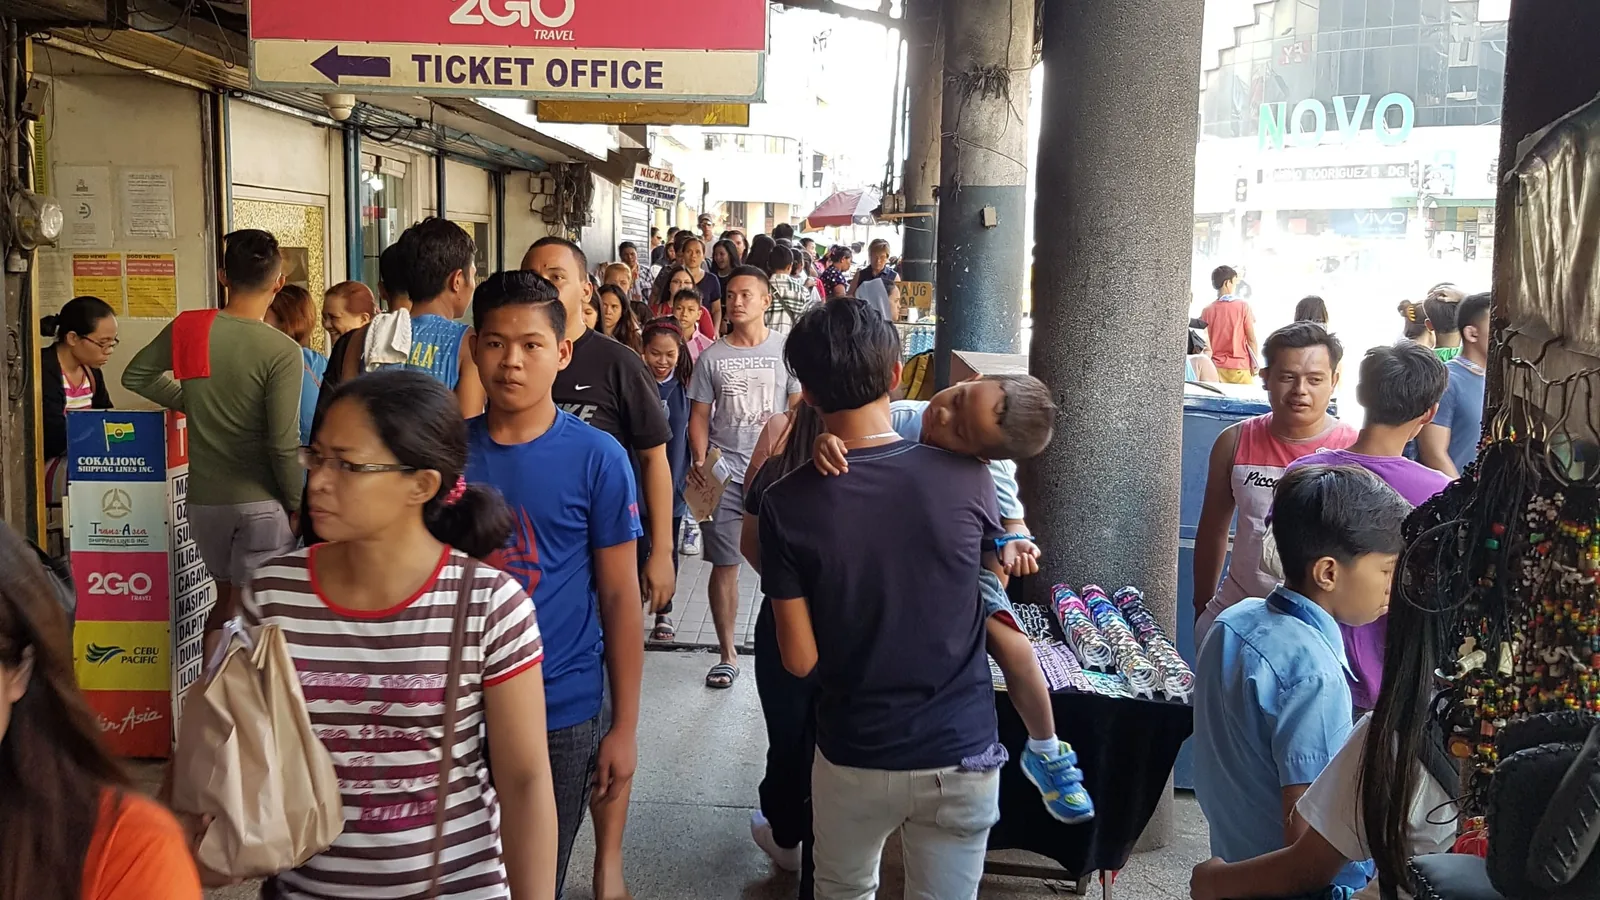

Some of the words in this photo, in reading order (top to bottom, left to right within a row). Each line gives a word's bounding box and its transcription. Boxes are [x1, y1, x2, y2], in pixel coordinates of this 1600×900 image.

[449, 0, 575, 27] 2GO
[534, 29, 575, 41] TRAVEL
[412, 54, 534, 87] TICKET
[546, 58, 664, 90] OFFICE
[1259, 92, 1415, 151] NOVO
[641, 167, 660, 180] NICK
[1305, 166, 1369, 180] RODRIGUEZ
[635, 179, 646, 188] KEY
[647, 183, 677, 194] DUPLICATE
[657, 191, 676, 201] STAMP
[1353, 209, 1405, 225] vivo
[716, 356, 778, 370] RESPECT
[77, 456, 145, 466] COKALIONG
[77, 465, 114, 473] SHIPPING
[115, 465, 138, 473] LINES
[139, 465, 155, 473] INC.
[178, 545, 202, 570] ILIGA
[87, 572, 152, 595] 2GO
[178, 565, 211, 593] CAGAYA
[178, 586, 211, 617] NASIPIT
[133, 646, 160, 655] CEBU
[120, 655, 158, 664] PACIFIC
